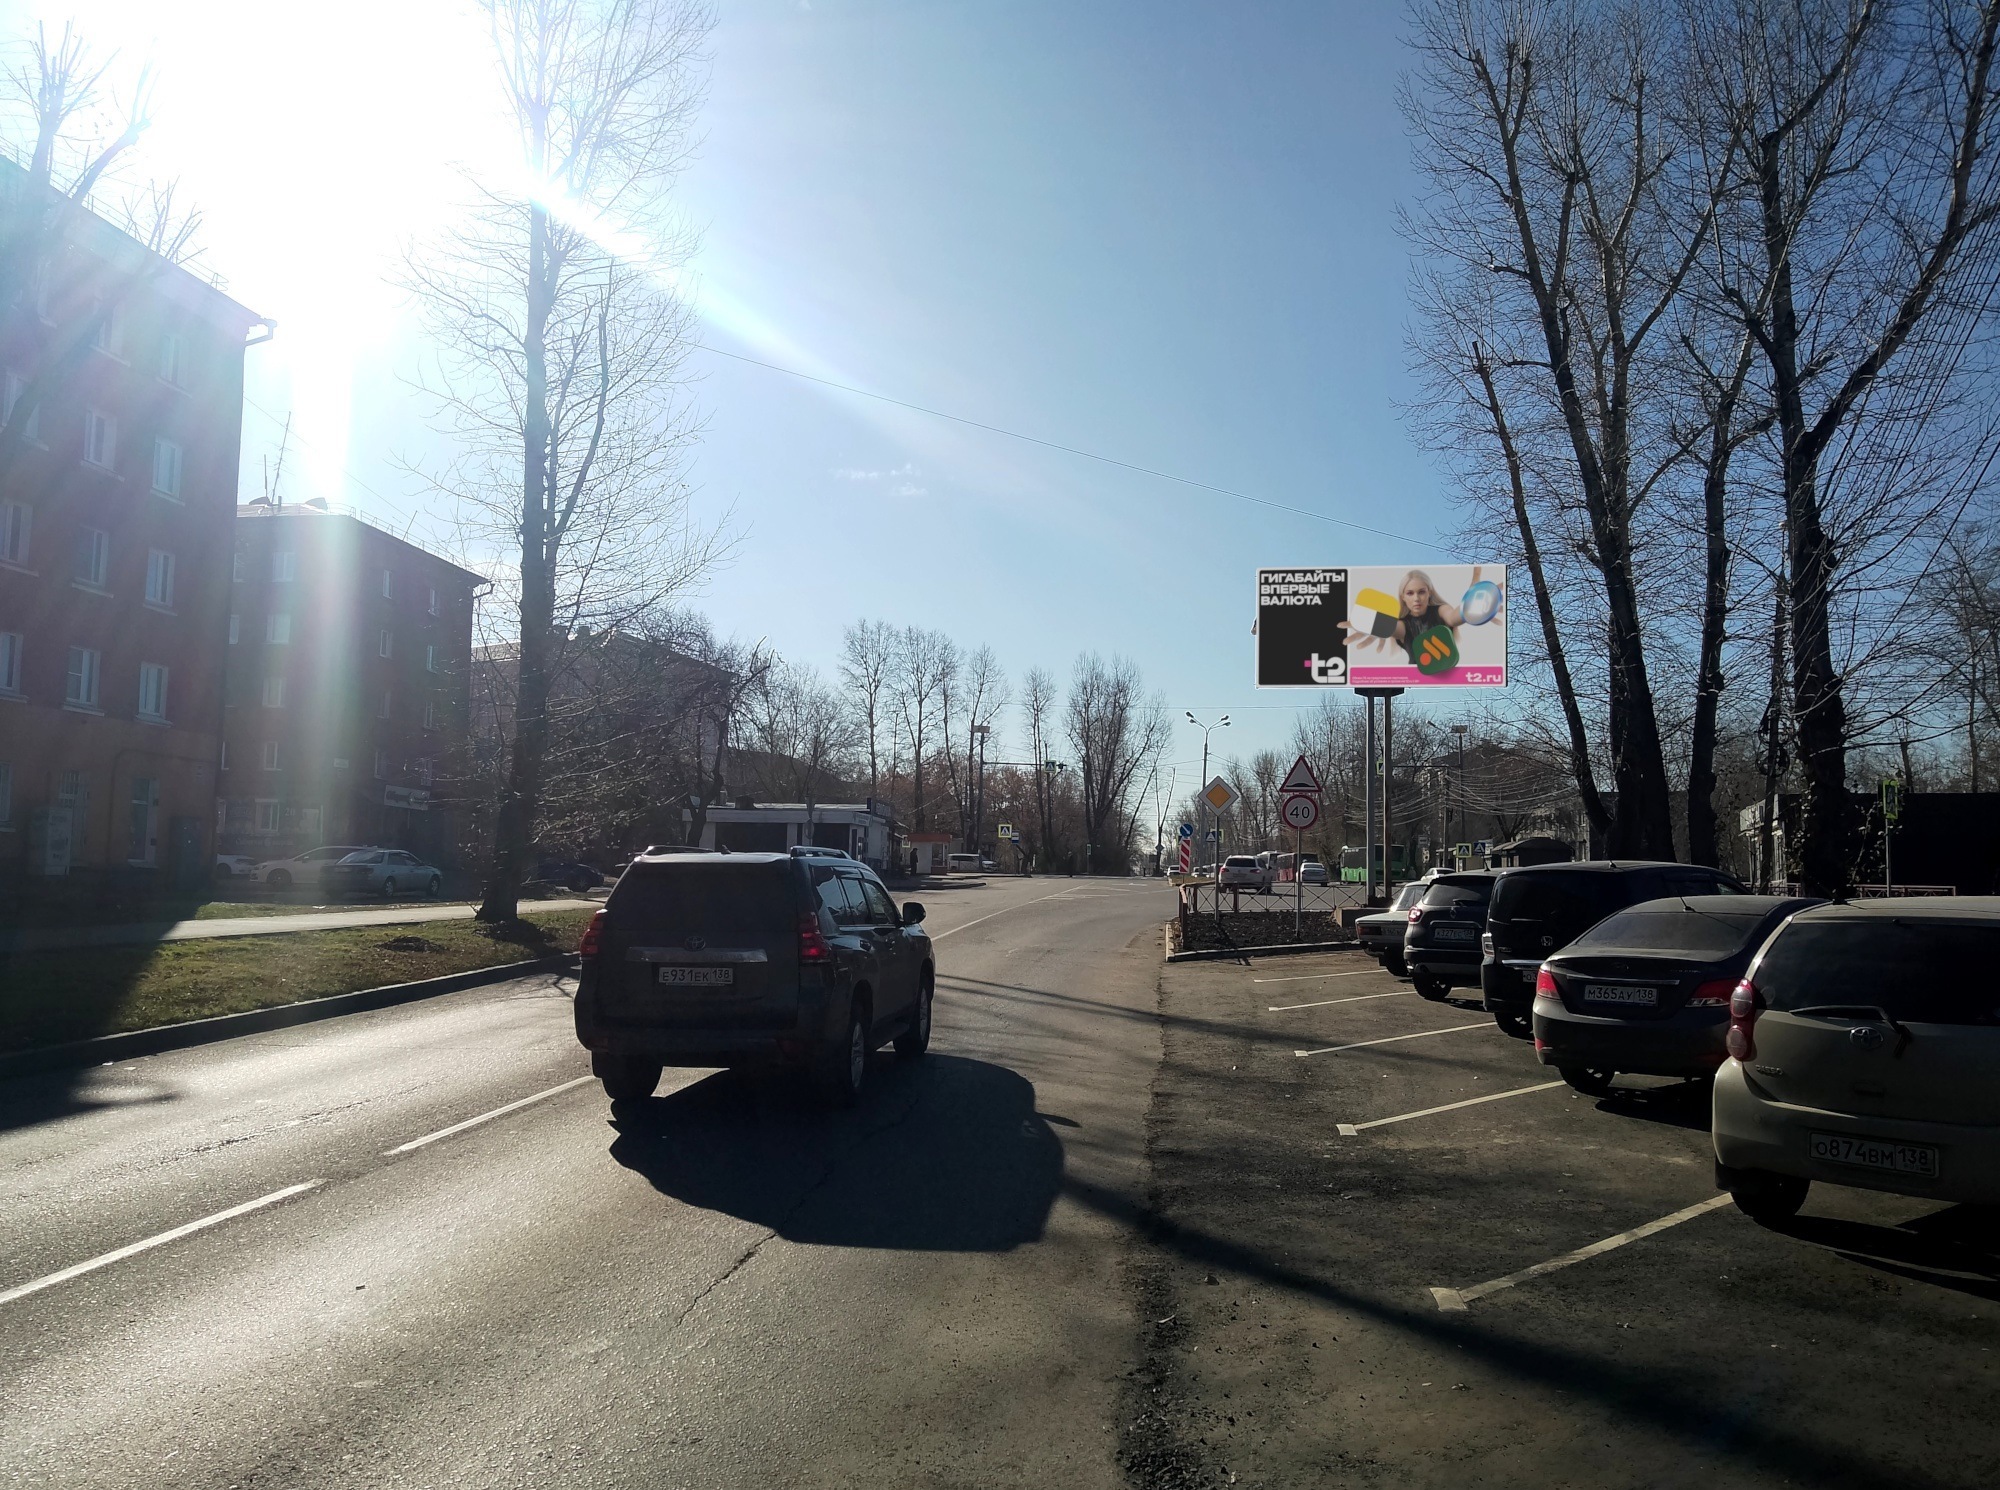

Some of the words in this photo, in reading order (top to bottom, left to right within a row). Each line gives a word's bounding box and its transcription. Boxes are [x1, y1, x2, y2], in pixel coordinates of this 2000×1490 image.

[1260, 570, 1345, 583] ГИГАБАЙТЫ
[1260, 584, 1330, 594] ВПЕРВЫЕ
[1260, 595, 1322, 606] ВАЛЮТА
[1304, 653, 1346, 684] t2
[1465, 672, 1502, 682] t2.ru
[1290, 806, 1310, 818] 40
[662, 969, 709, 982] Е931ЕК
[712, 968, 730, 979] 138
[1587, 987, 1633, 1000] М365АУ
[1636, 989, 1653, 999] 138
[1816, 1139, 1894, 1167] О874ВМ
[1898, 1148, 1929, 1165] 138
